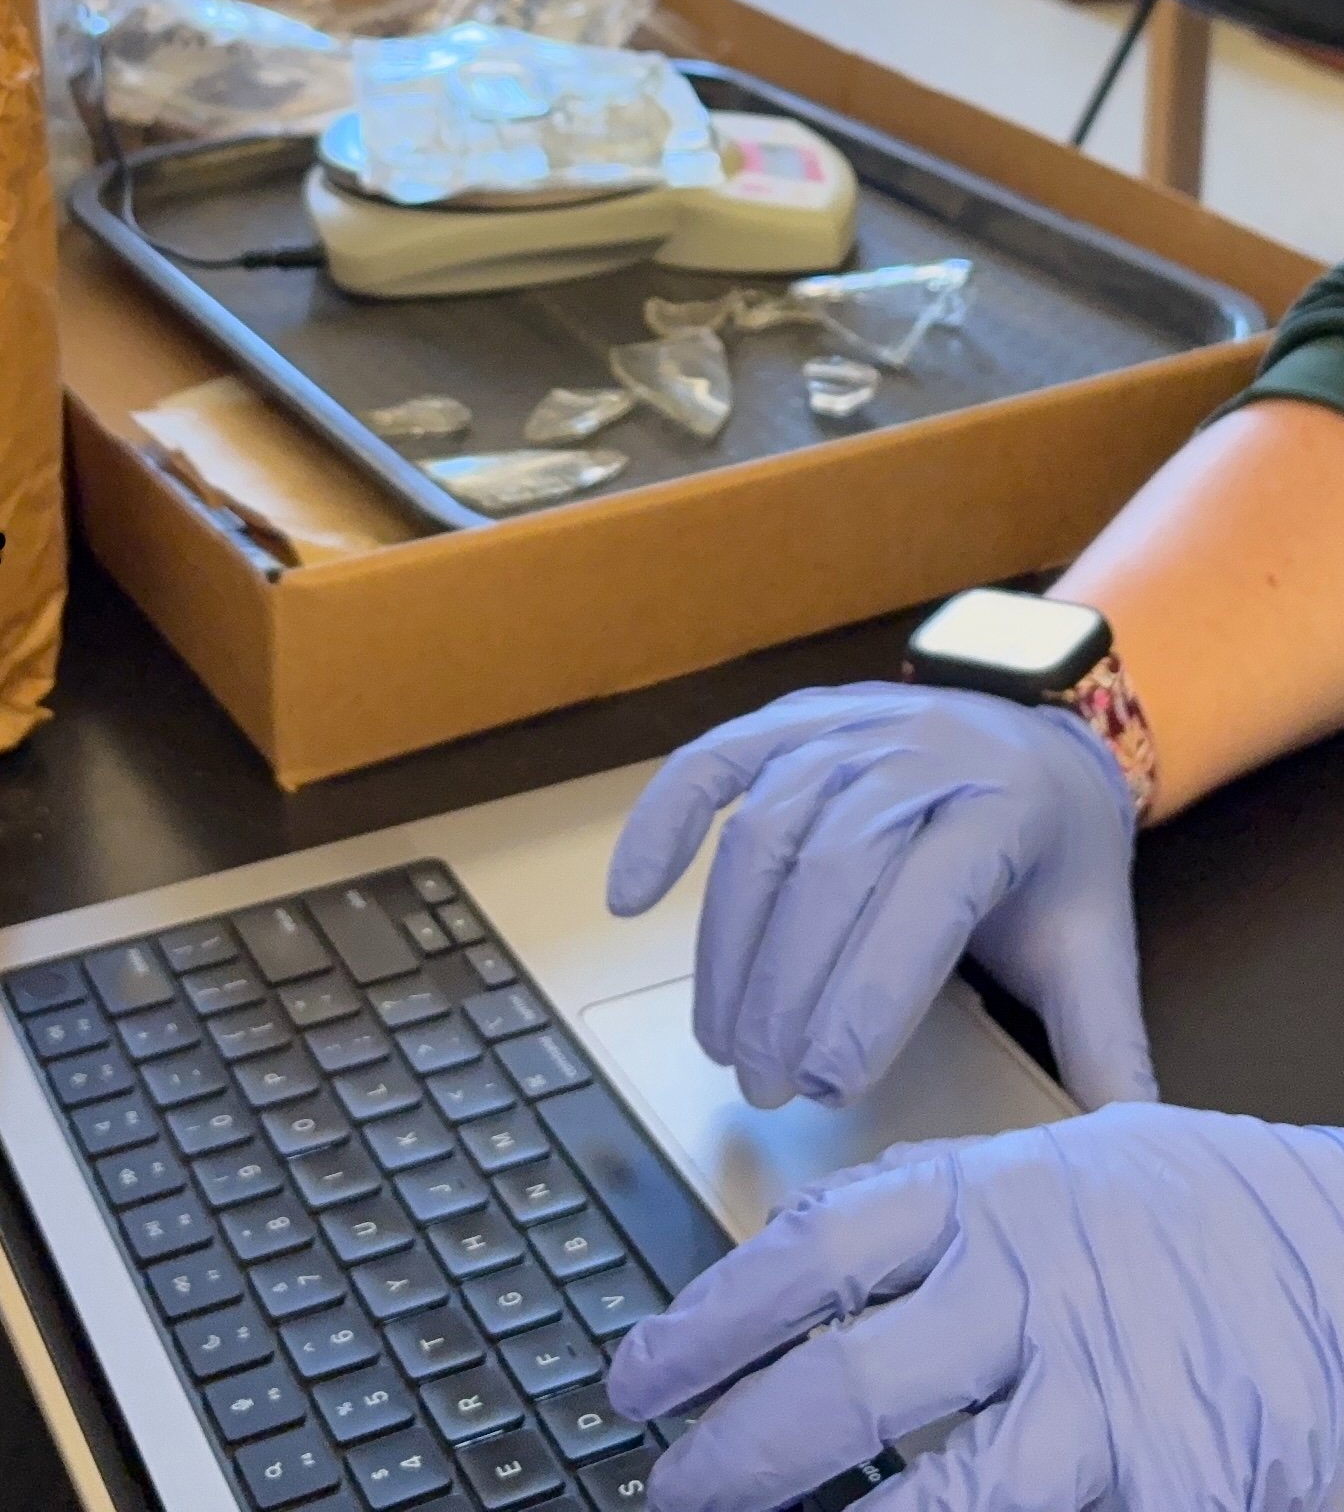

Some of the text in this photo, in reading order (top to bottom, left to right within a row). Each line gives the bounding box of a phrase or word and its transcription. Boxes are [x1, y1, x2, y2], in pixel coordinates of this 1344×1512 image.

[395, 1131, 418, 1147] K
[490, 1131, 516, 1148] M
[237, 1164, 262, 1179] 9
[525, 1183, 551, 1200] N
[265, 1216, 291, 1231] 8
[351, 1221, 378, 1237] U
[461, 1234, 487, 1252] H
[564, 1237, 589, 1253] B
[296, 1274, 323, 1286] 7
[385, 1278, 410, 1292] Y
[497, 1291, 524, 1308] G
[601, 1295, 626, 1309] V
[329, 1328, 355, 1344] 6
[419, 1336, 446, 1353] T
[535, 1352, 561, 1367] F
[363, 1390, 389, 1407] 5
[457, 1393, 485, 1413] R
[577, 1412, 604, 1431] D
[399, 1454, 424, 1469] 4
[495, 1459, 523, 1479] E
[617, 1478, 645, 1498] S
